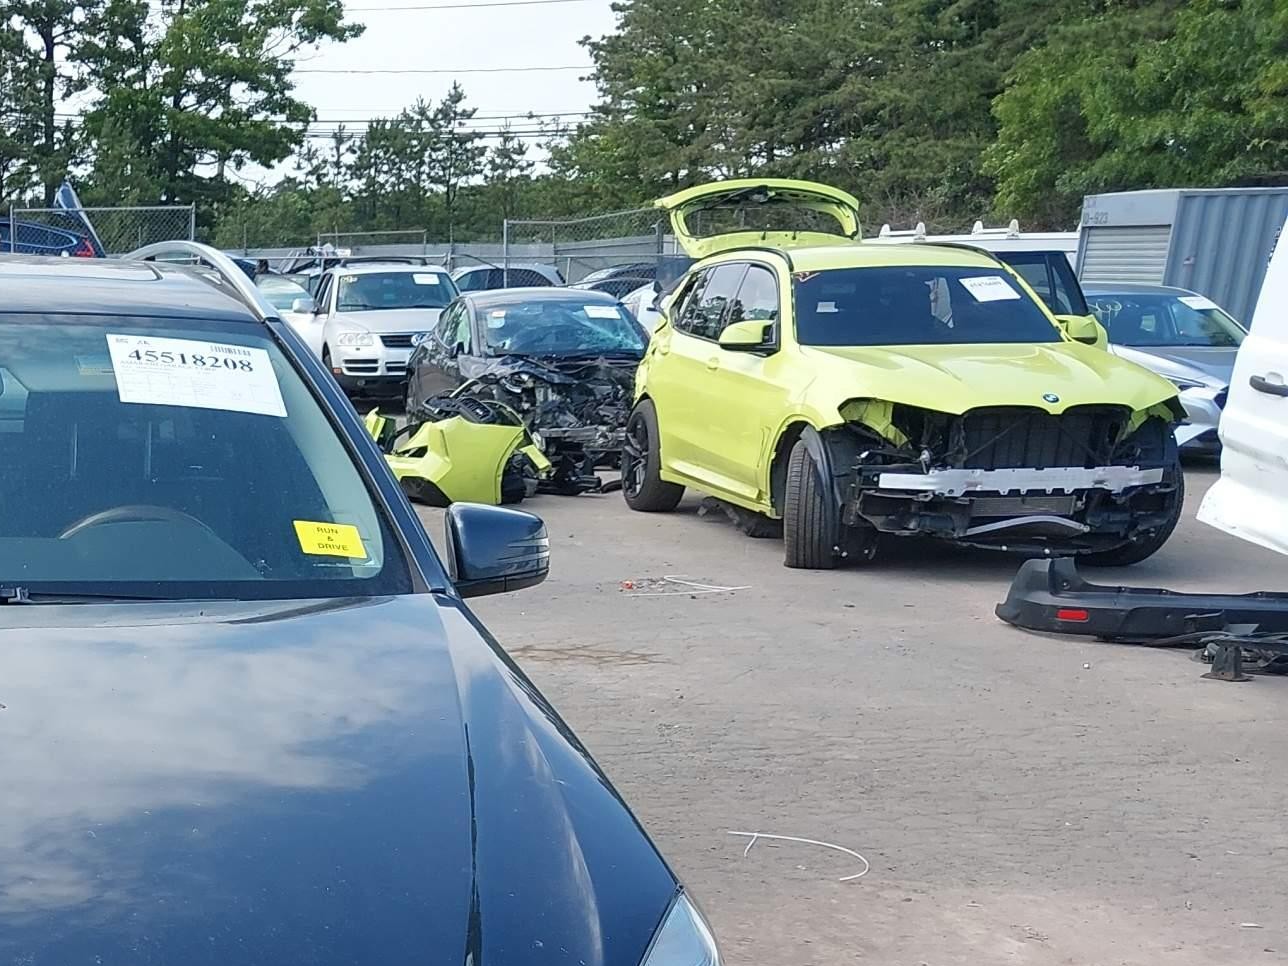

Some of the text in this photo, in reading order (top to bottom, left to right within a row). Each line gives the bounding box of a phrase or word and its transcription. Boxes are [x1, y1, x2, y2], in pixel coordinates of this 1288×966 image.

[128, 349, 254, 373] 45518208
[316, 527, 339, 535] RUN
[317, 543, 350, 552] DRIVE
